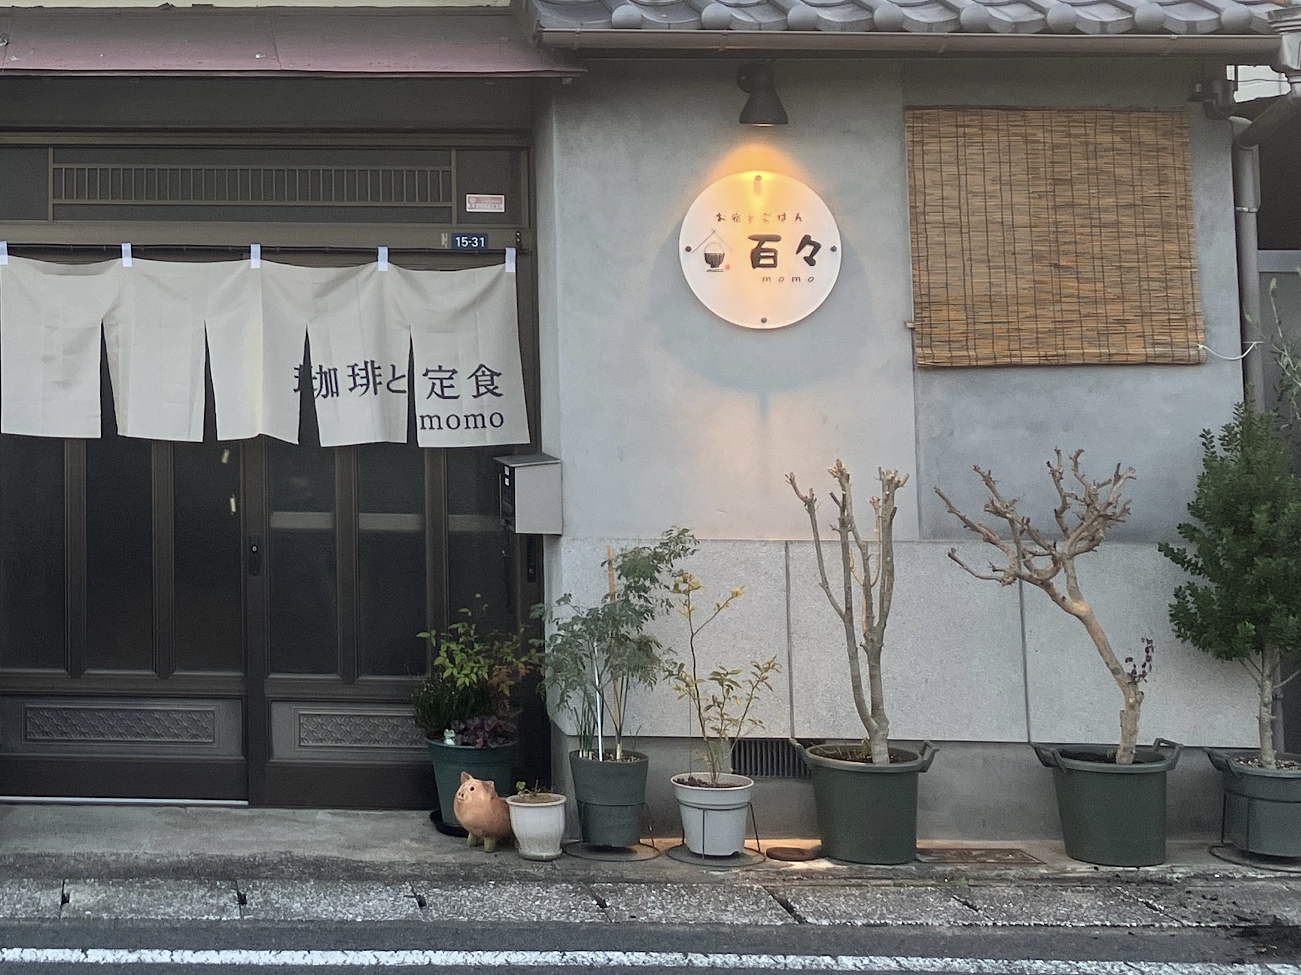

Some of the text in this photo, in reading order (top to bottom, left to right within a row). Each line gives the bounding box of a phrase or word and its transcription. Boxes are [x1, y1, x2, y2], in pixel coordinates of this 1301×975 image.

[455, 236, 485, 248] 15-31
[747, 234, 822, 269] 百々
[762, 275, 814, 283] momo
[419, 411, 504, 431] momo
